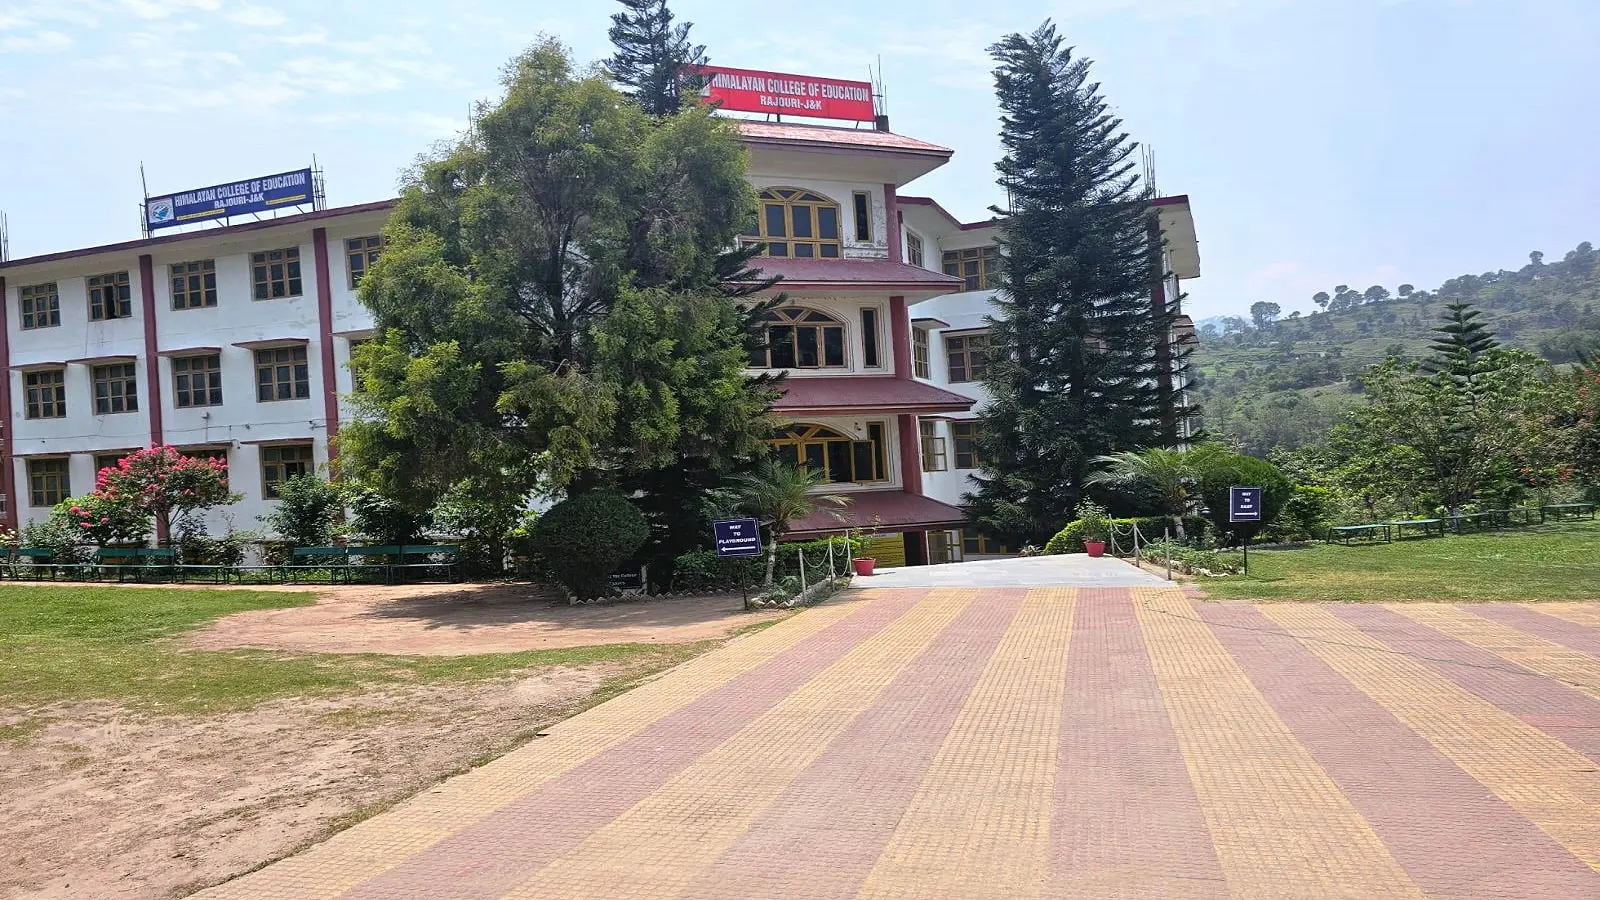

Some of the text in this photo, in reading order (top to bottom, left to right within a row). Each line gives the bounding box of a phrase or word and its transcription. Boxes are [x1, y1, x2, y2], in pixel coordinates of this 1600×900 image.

[712, 73, 869, 102] HIMALAYAN COLLEGE OF EDUCATION
[760, 95, 822, 111] RAJOURI-J&K
[175, 172, 305, 207] HIMALAYAN COLLEGE OF EDUCATION
[214, 193, 264, 209] RAJOURI-J&K
